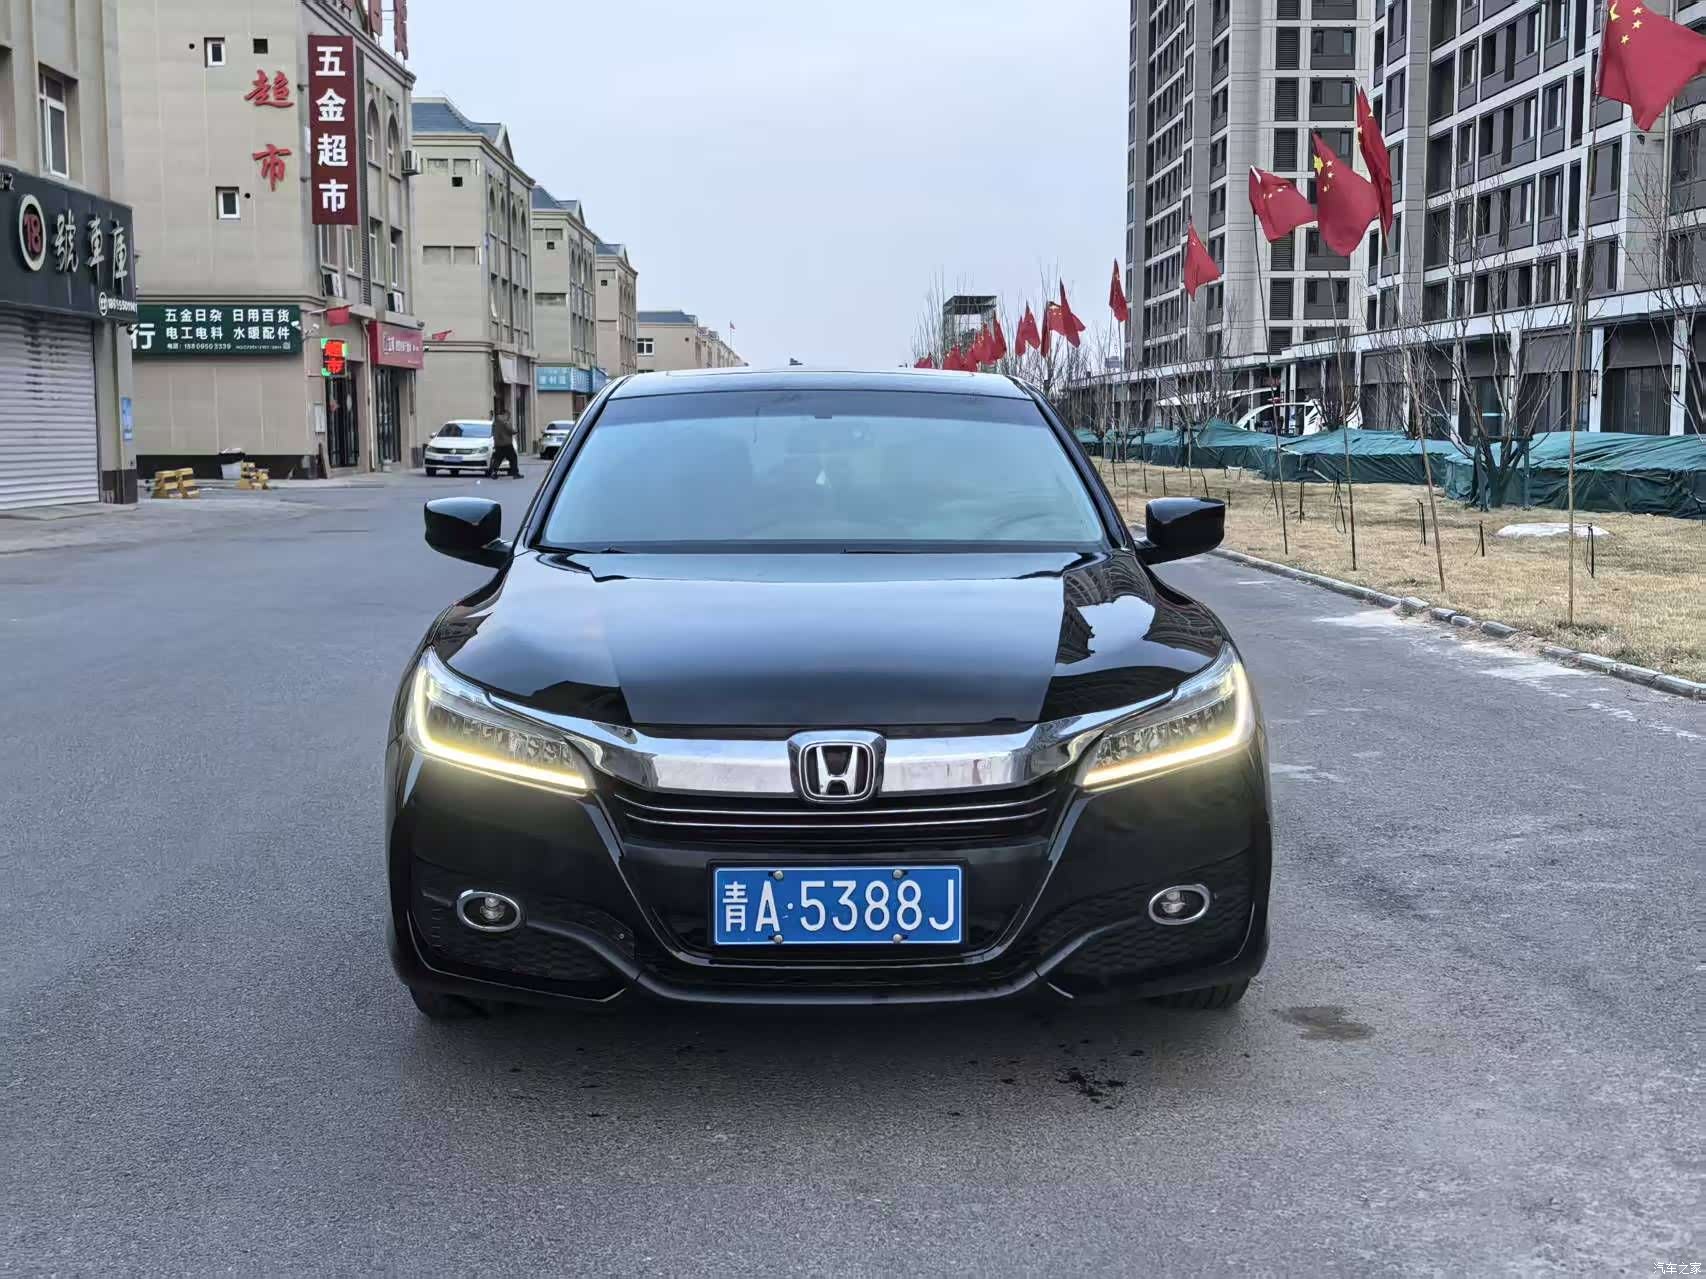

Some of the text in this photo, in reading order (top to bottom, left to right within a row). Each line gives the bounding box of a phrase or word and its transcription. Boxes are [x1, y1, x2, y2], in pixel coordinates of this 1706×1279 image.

[244, 69, 295, 192] 超市
[315, 46, 348, 212] 五金超市
[165, 308, 291, 323] 五金日杂 日用百货
[130, 323, 156, 350] 行
[165, 326, 291, 341] 电工电料 水暖配件
